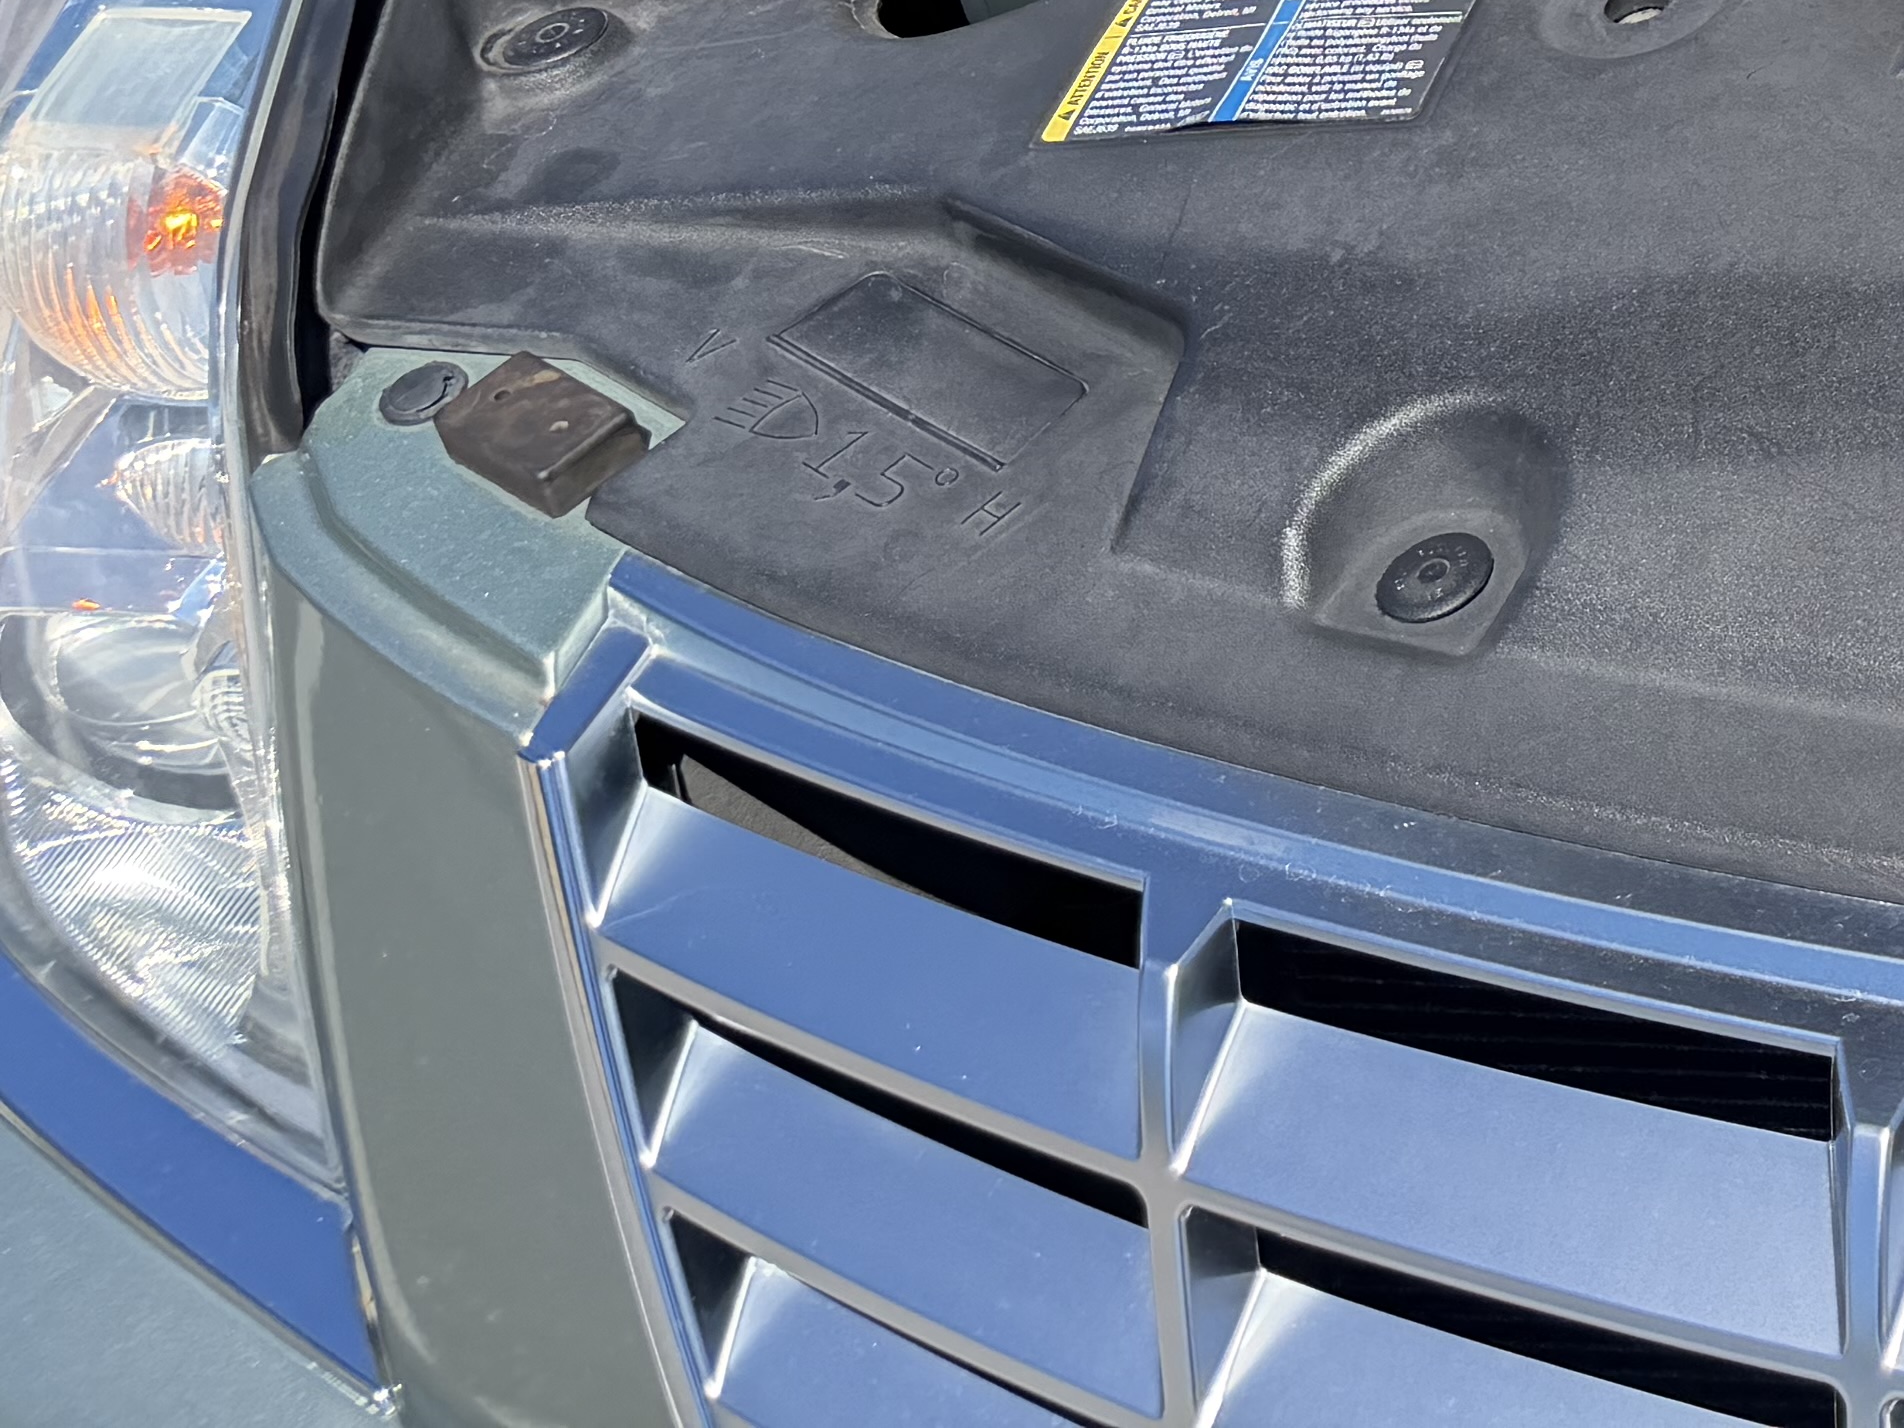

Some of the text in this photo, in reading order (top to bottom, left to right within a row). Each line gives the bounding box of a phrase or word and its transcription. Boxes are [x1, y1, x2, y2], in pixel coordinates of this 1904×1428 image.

[1069, 51, 1109, 105] ATTENTION
[686, 329, 735, 363] V
[961, 491, 1021, 536] H
